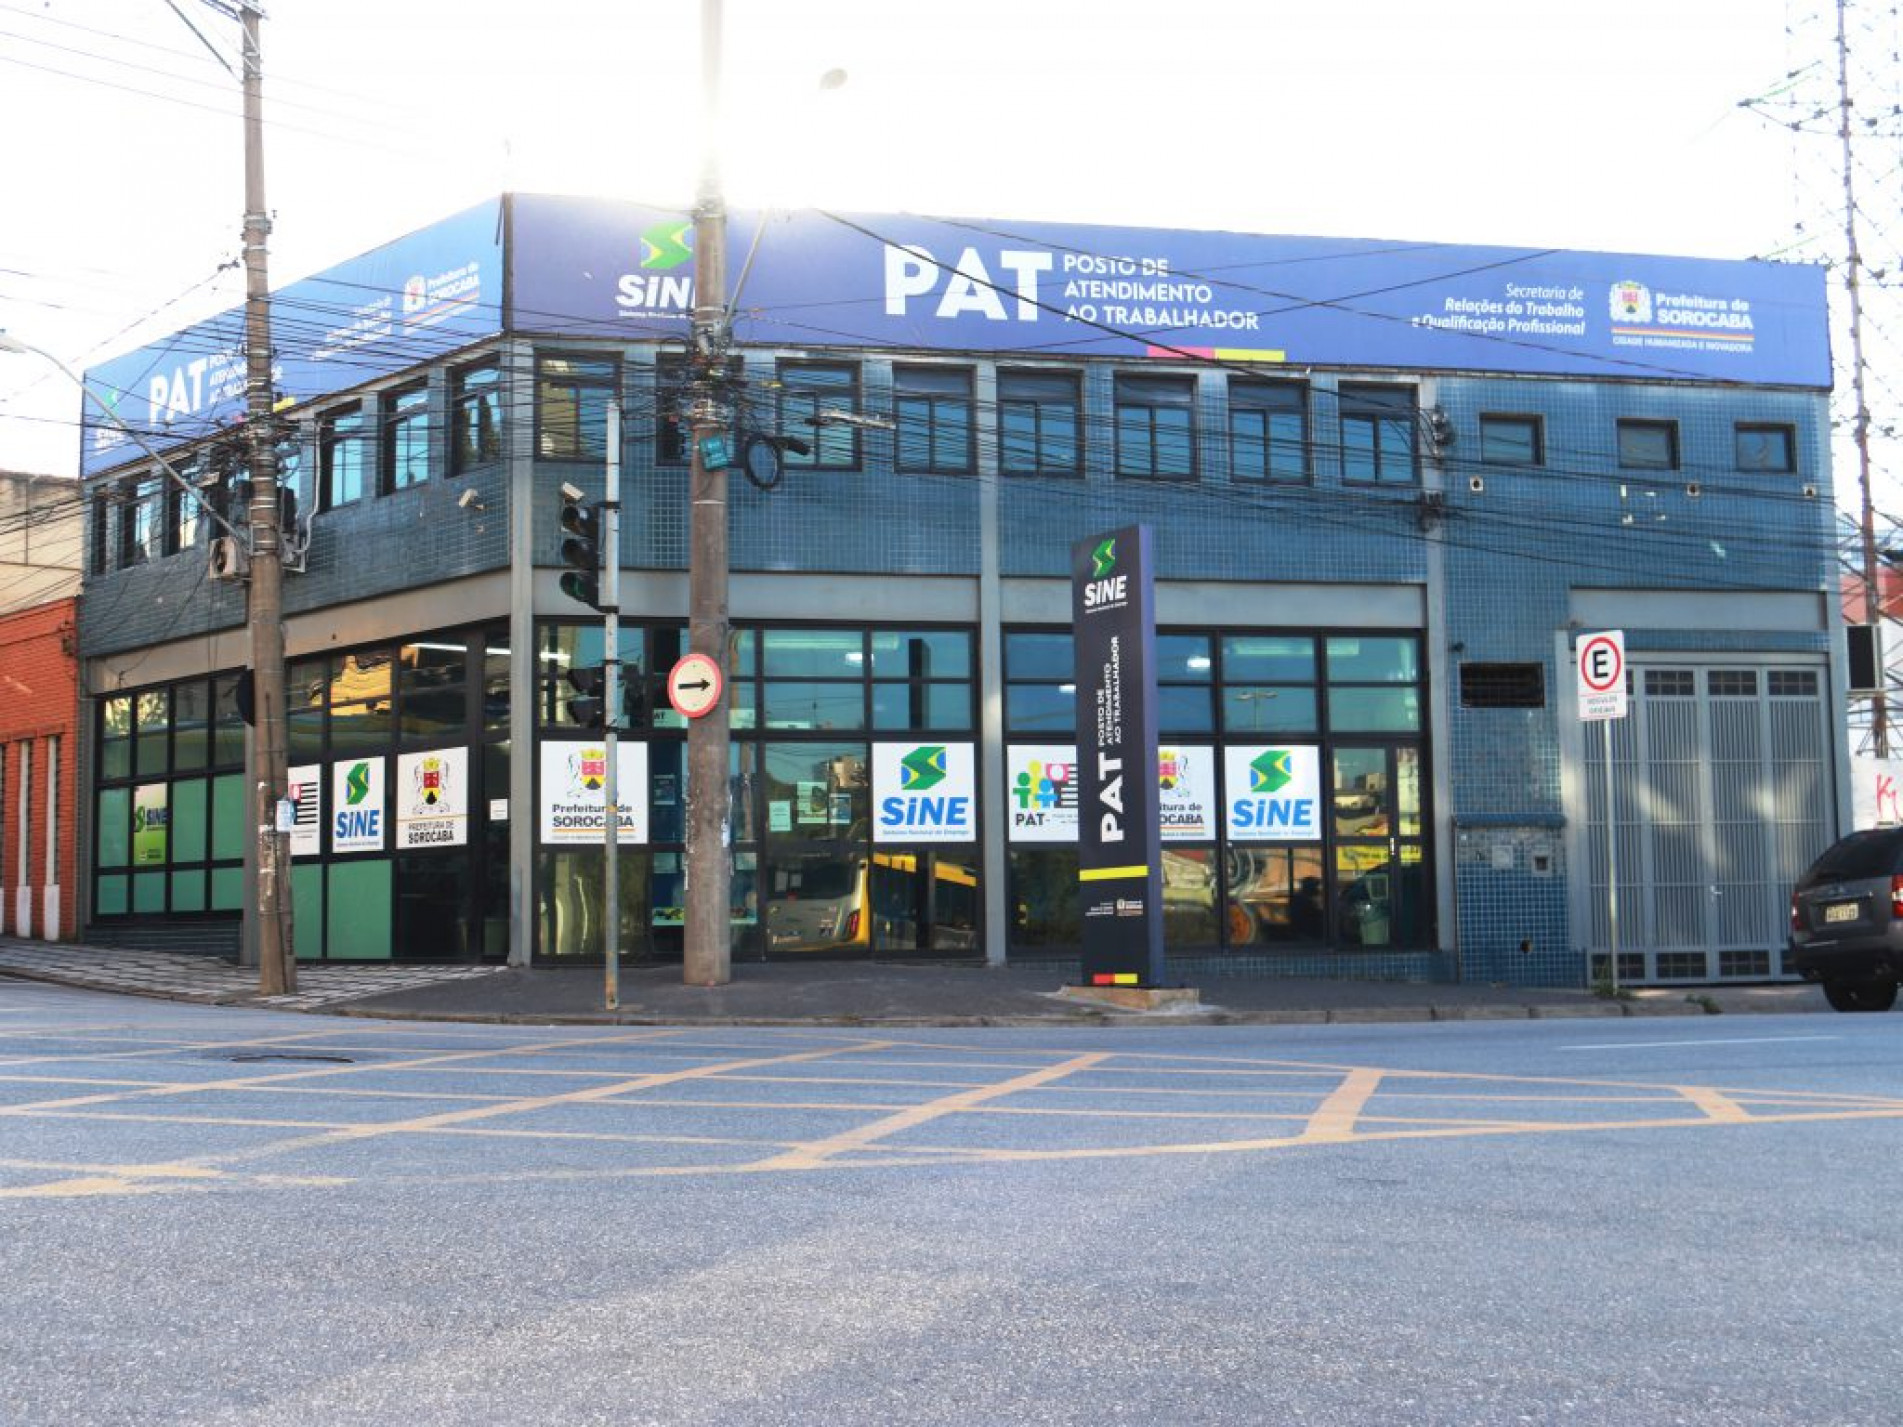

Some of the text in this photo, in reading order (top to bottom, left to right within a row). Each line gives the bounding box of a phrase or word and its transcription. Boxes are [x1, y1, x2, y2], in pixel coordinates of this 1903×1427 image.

[1064, 254, 1169, 277] POSTO DE
[615, 274, 696, 309] SiN
[884, 244, 1053, 322] PAT
[1064, 280, 1213, 304] ATENDIMENTO
[1505, 283, 1584, 300] Secretaria de
[1065, 304, 1260, 330] AO TRABALHADOR
[1526, 302, 1585, 318] Trabalho
[1657, 309, 1754, 330] SOROCABA
[1508, 318, 1586, 336] Profissional
[149, 355, 208, 427] PAT
[1592, 650, 1608, 678] E
[552, 804, 606, 813] Prefeitur
[1098, 752, 1125, 843] PAT
[1188, 802, 1203, 811] de
[552, 815, 635, 828] SOROCBA
